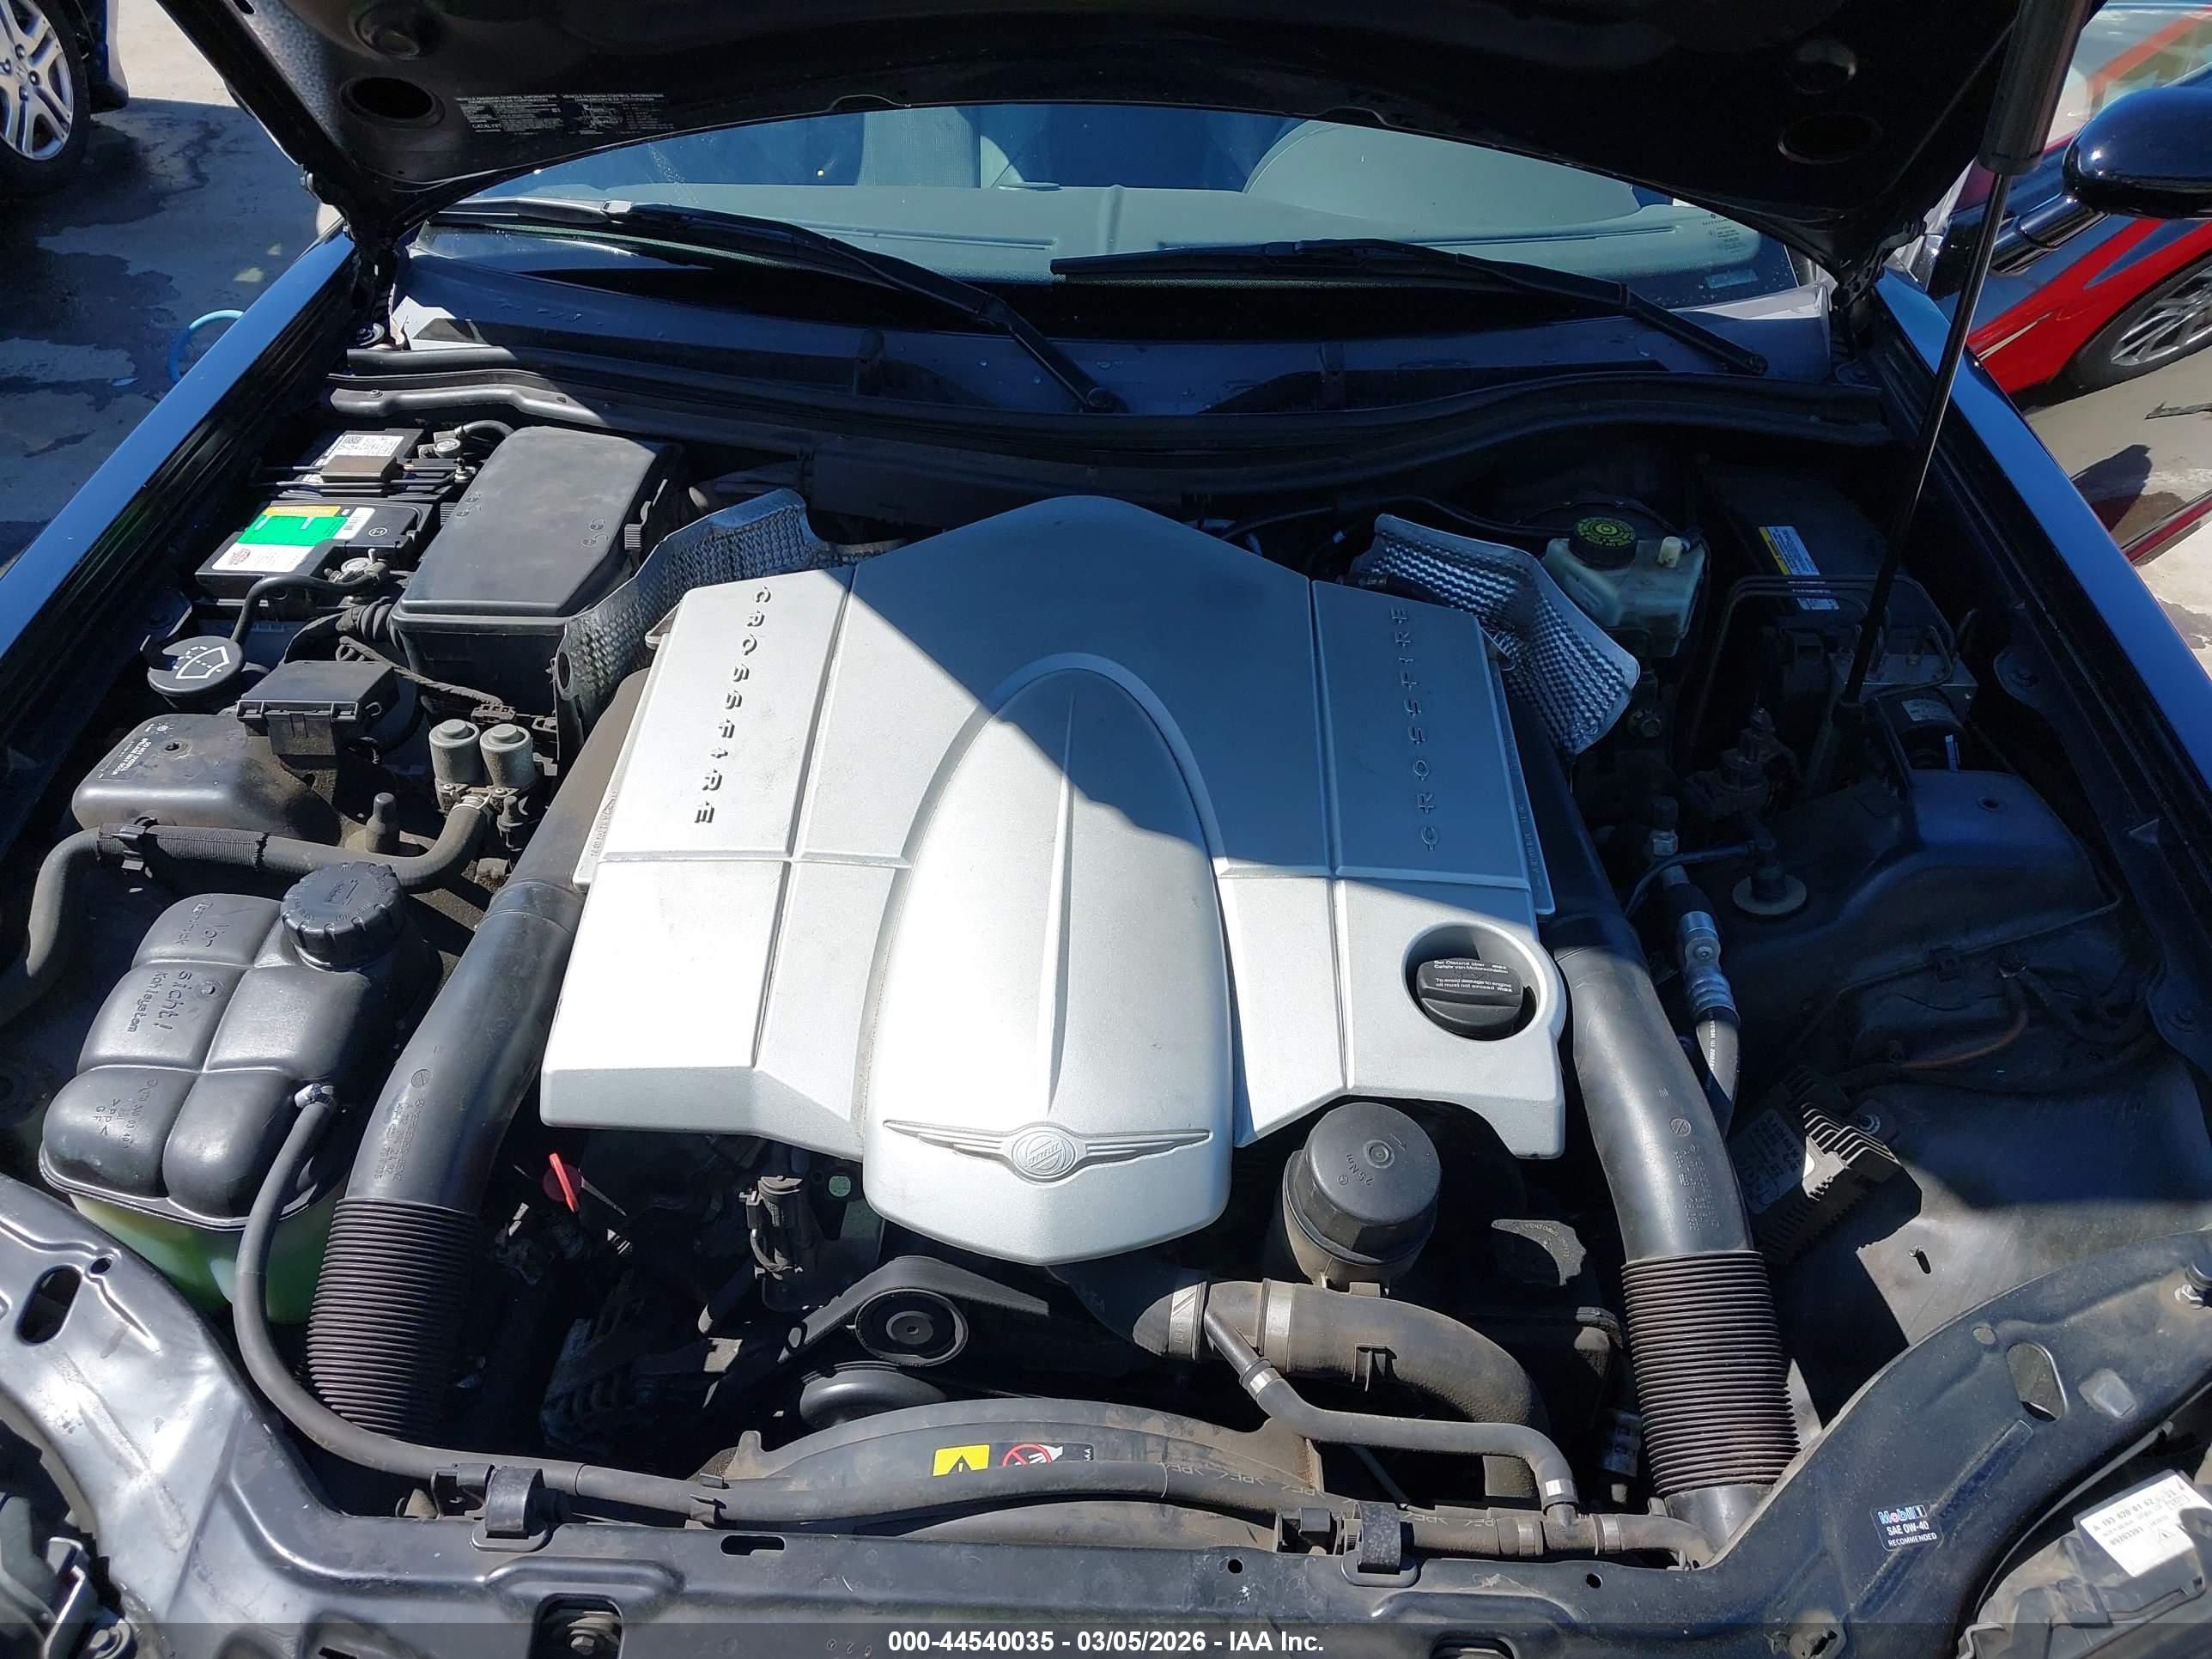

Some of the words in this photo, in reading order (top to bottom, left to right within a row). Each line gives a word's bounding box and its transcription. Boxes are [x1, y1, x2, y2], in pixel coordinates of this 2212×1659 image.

[694, 585, 773, 824] CROSSFIRE
[1389, 606, 1440, 852] CROSSFIRE
[1878, 1507, 1917, 1525] Mobil
[1886, 1524, 1904, 1536] SAE
[1902, 1520, 1930, 1534] 0W-40
[1887, 1532, 1938, 1547] RECOMMENDED
